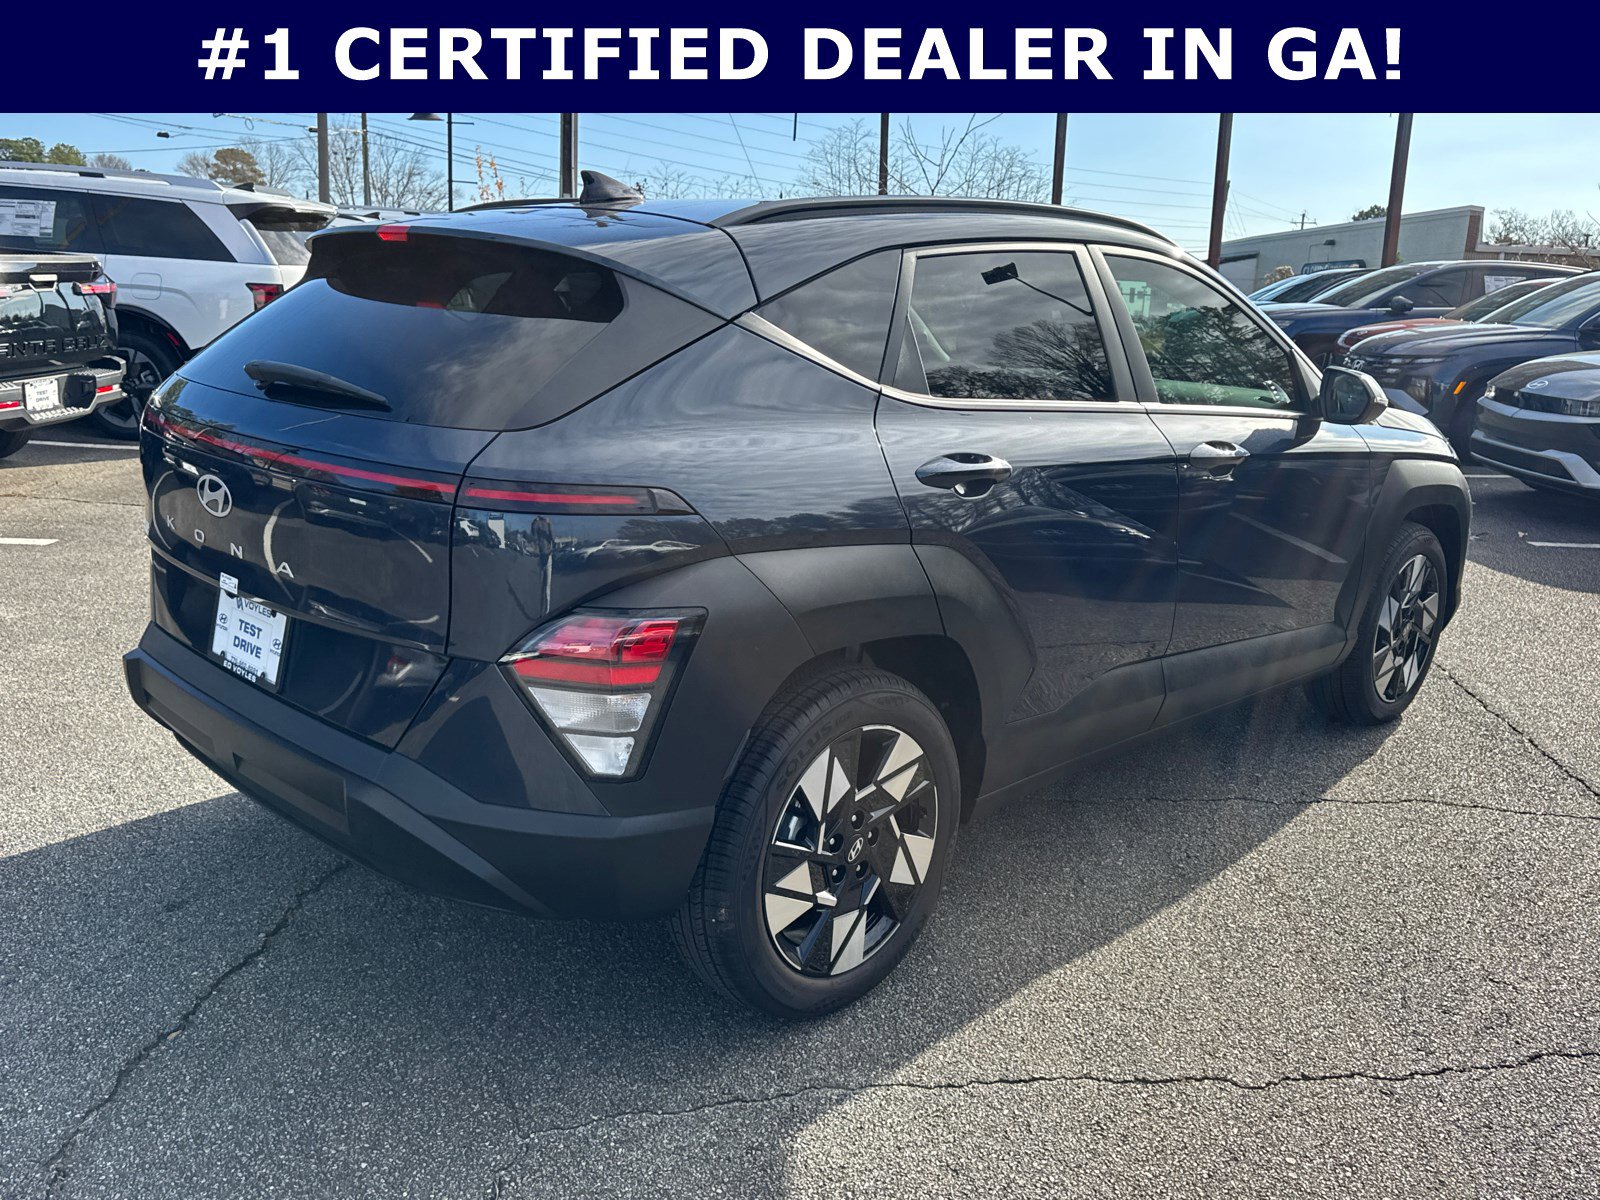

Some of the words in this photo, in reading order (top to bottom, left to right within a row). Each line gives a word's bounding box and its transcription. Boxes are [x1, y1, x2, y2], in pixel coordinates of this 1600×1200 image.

[0, 339, 57, 358] ANTA
[166, 514, 295, 579] KONA
[244, 599, 273, 619] VOYLES
[238, 618, 263, 640] TEST
[232, 635, 262, 660] DRIVE
[223, 660, 233, 670] ED
[232, 664, 258, 684] VOYLES
